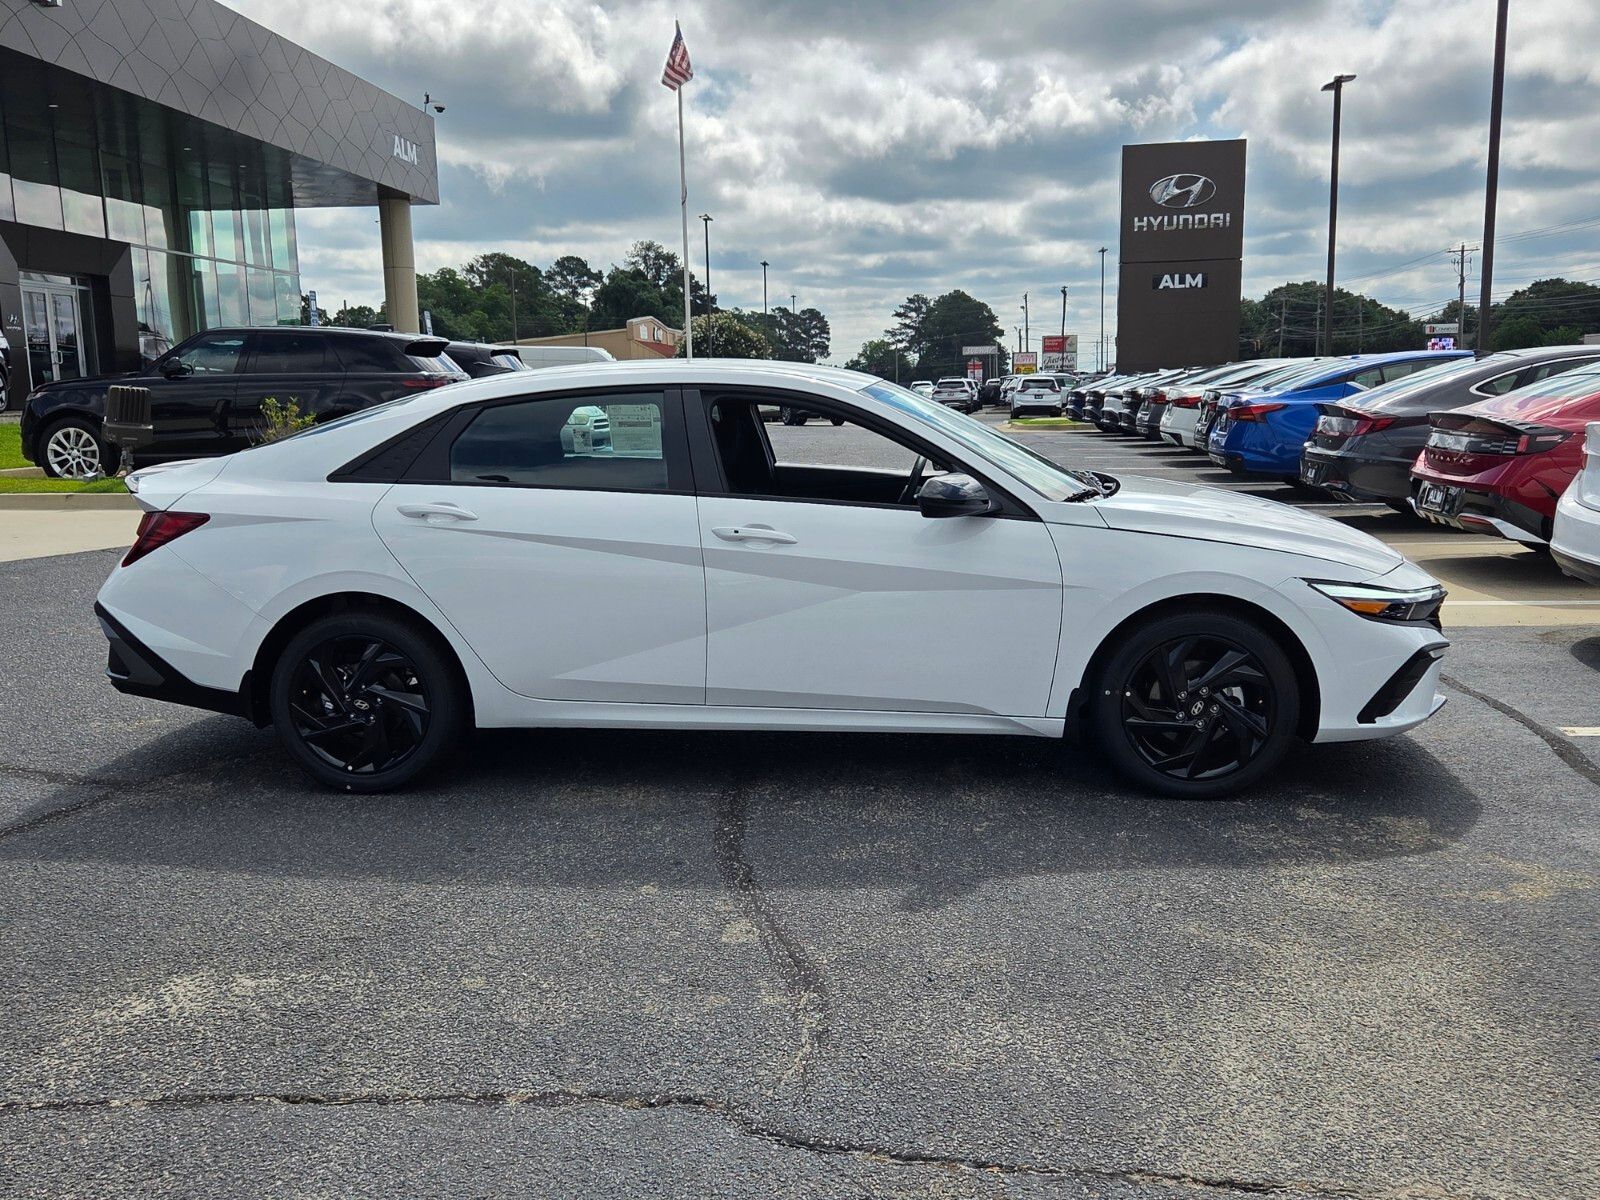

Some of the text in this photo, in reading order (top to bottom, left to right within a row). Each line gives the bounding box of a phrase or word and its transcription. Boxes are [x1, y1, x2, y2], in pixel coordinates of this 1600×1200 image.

[393, 134, 418, 166] ALM
[1133, 212, 1231, 232] HYUNDAI
[1158, 273, 1203, 290] ALM
